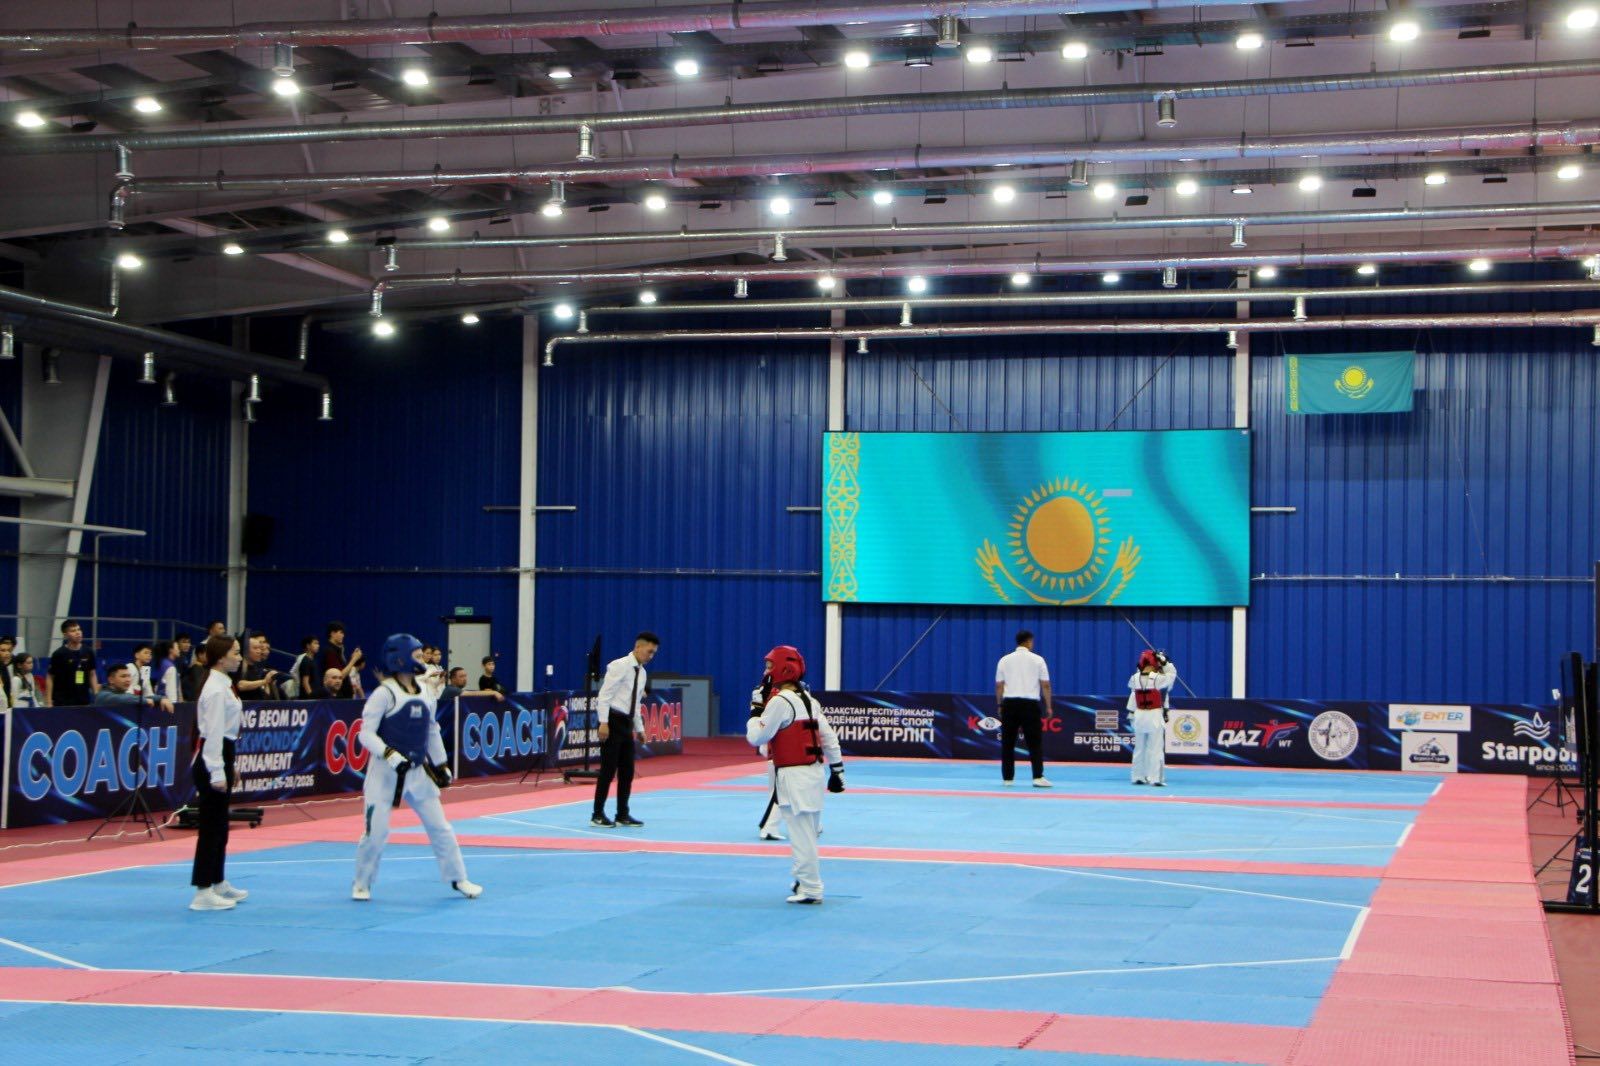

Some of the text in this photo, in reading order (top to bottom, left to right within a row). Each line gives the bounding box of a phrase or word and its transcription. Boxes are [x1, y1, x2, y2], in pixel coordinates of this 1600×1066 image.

[258, 709, 290, 727] BEOM
[291, 709, 308, 726] DO
[867, 708, 935, 717] РЕСПУБЛИКАСЫ
[1423, 711, 1464, 721] ENTER
[640, 702, 681, 742] OACH
[827, 715, 934, 727] ӘДЕНИЕТ ЖӘНЕ СПОРТ
[463, 709, 547, 760] COACH
[833, 727, 934, 743] ИНИСТРЛІГІ
[1093, 744, 1121, 752] CLUB
[1278, 739, 1293, 748] WT
[18, 725, 178, 800] COACH
[1575, 863, 1592, 893] 2
